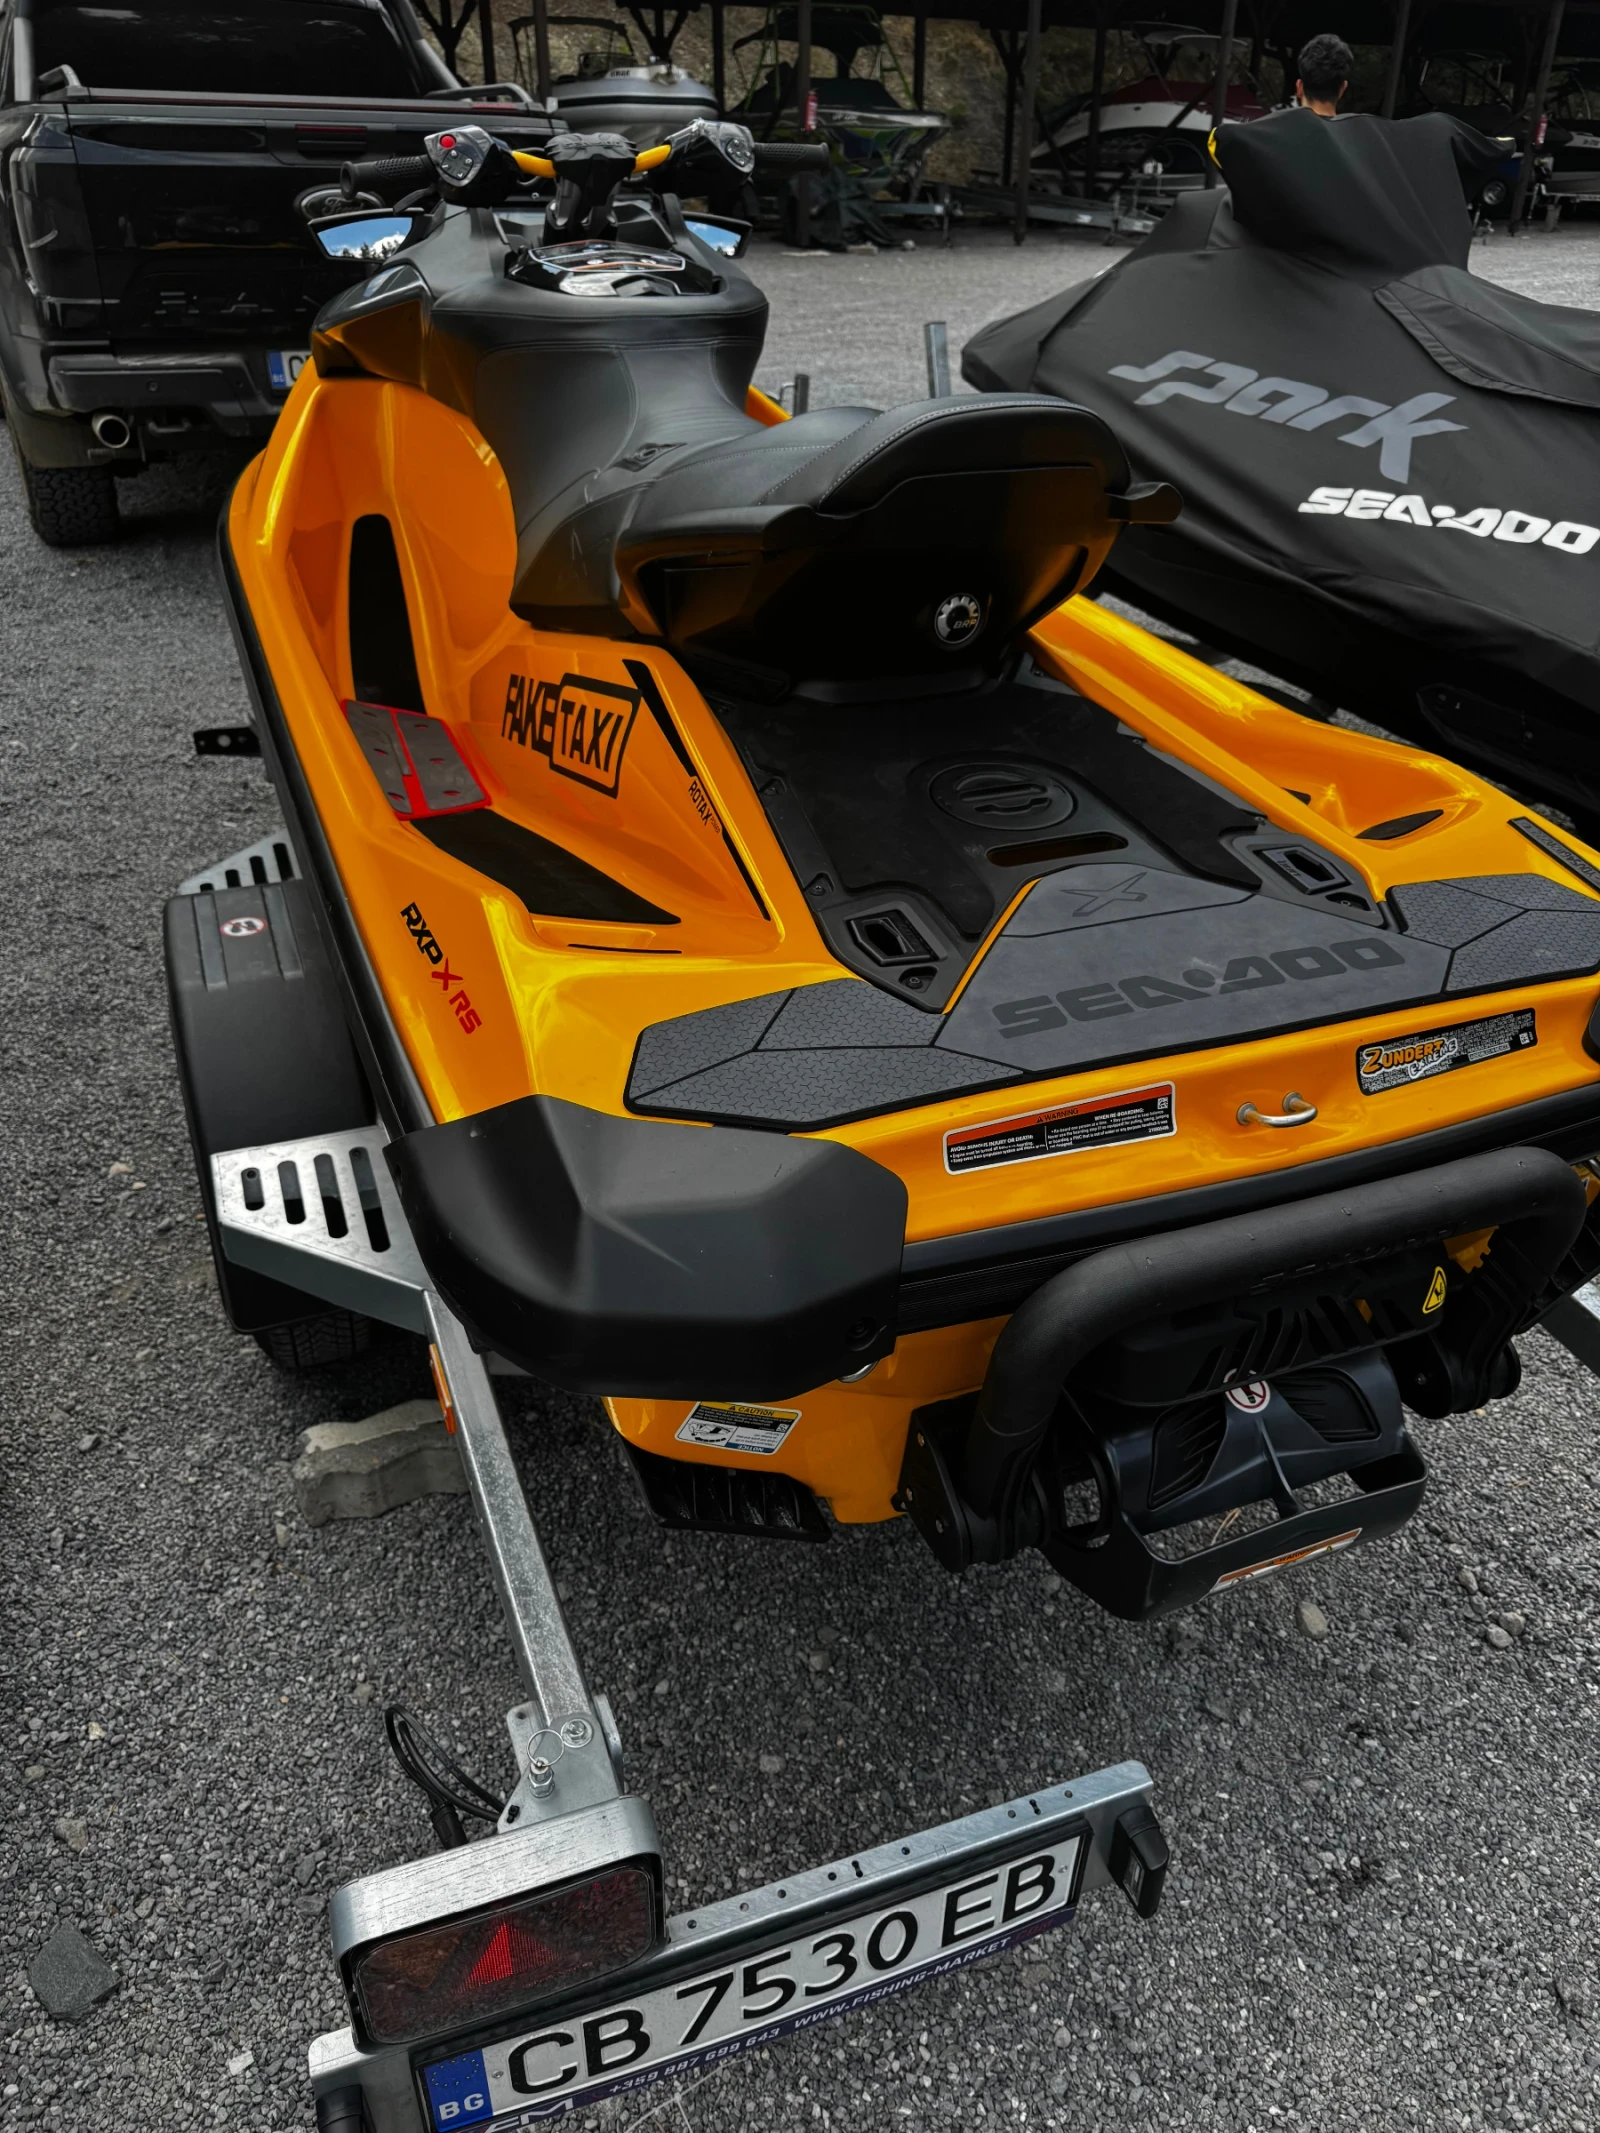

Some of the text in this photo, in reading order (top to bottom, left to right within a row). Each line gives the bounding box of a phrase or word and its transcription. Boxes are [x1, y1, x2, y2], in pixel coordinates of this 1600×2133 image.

[953, 619, 977, 629] BRP
[501, 673, 559, 758] FAKE
[560, 698, 625, 773] TAXI
[688, 780, 713, 827] ROTAX
[400, 902, 444, 965] RXP
[449, 989, 483, 1035] RS
[1362, 1039, 1444, 1075] ZUNDERT
[1044, 1107, 1079, 1121] WARNING
[738, 1406, 775, 1417] CAUTION
[738, 1444, 765, 1453] NOTICE
[508, 1854, 1056, 2095] CB 7530 EB
[609, 2071, 659, 2095] +359
[663, 2056, 701, 2079] 887
[704, 2041, 741, 2064] 699
[744, 2026, 781, 2048] 643
[438, 2092, 485, 2122] BG
